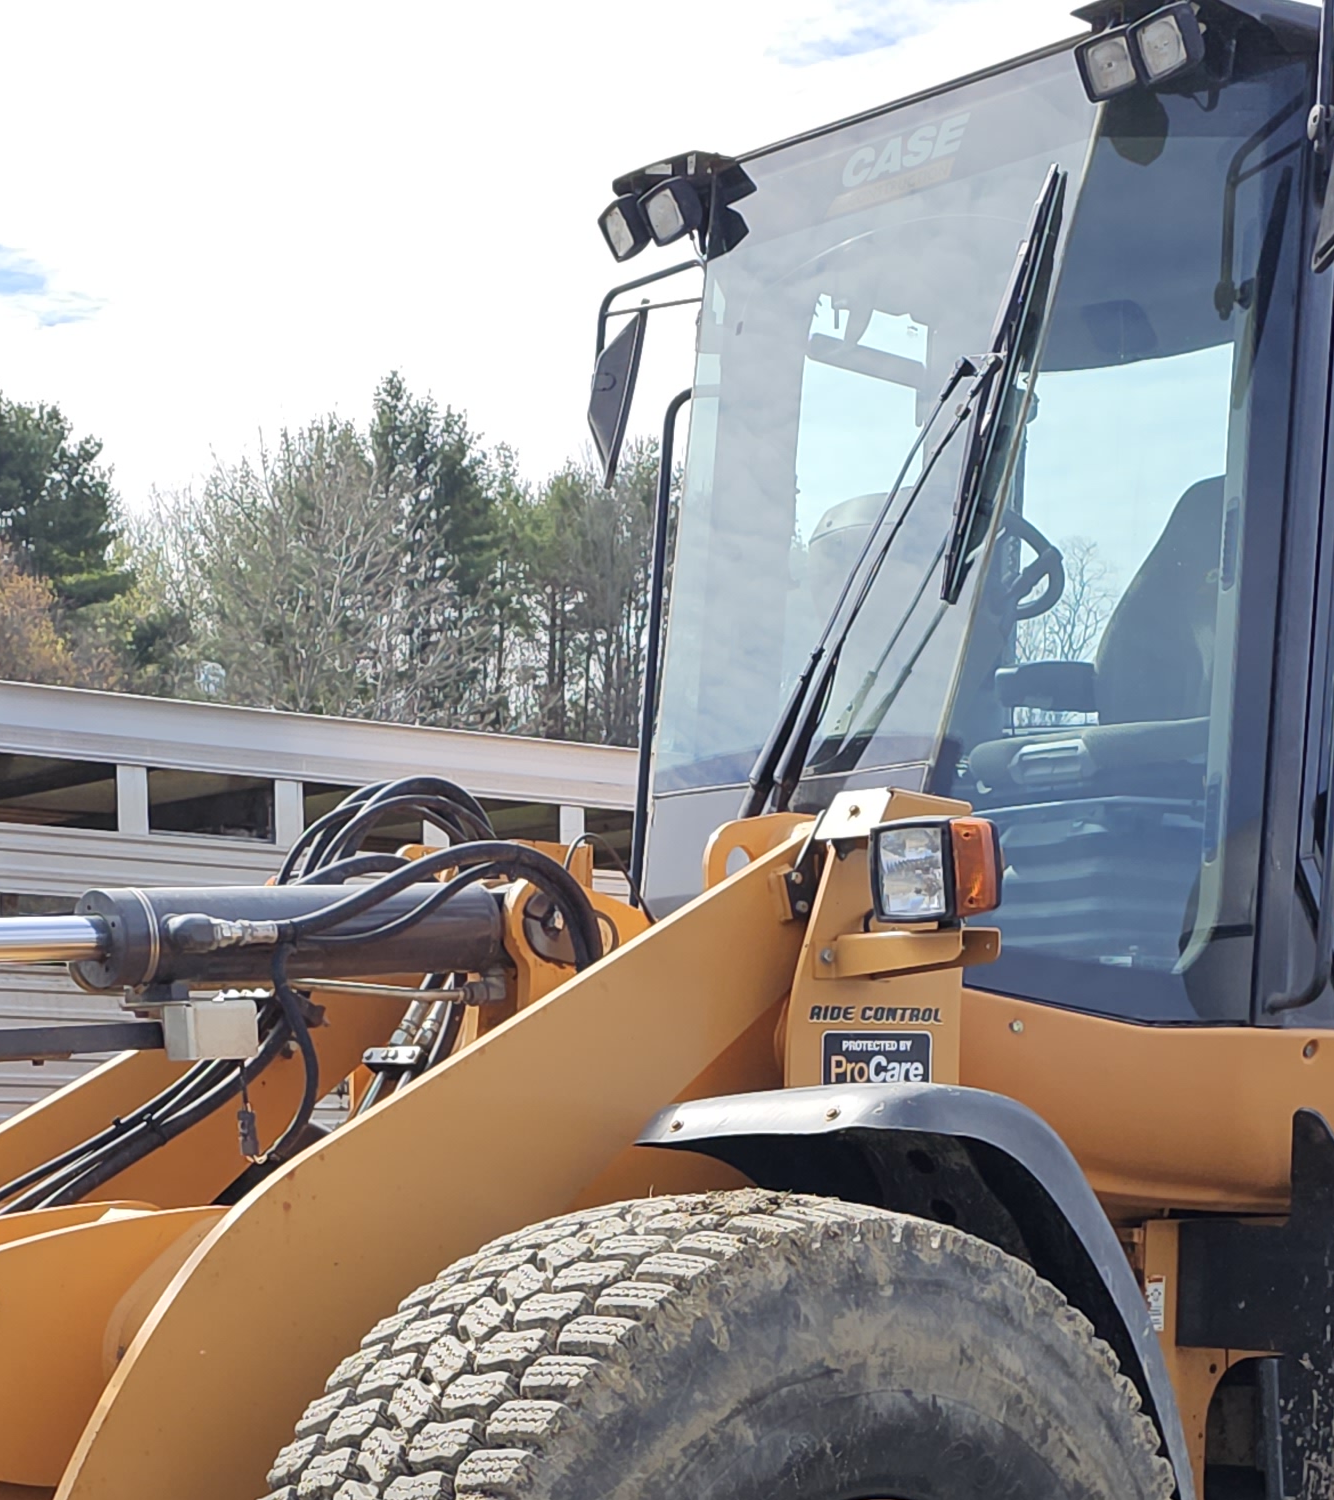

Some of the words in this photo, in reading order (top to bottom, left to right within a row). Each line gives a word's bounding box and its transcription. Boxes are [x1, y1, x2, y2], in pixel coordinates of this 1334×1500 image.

[842, 112, 971, 187] CASE
[809, 1005, 856, 1022] RIDE
[860, 1006, 944, 1023] CONTROL
[841, 1040, 898, 1051] PROTECTED
[899, 1040, 913, 1051] BY
[830, 1055, 925, 1083] ProCare
